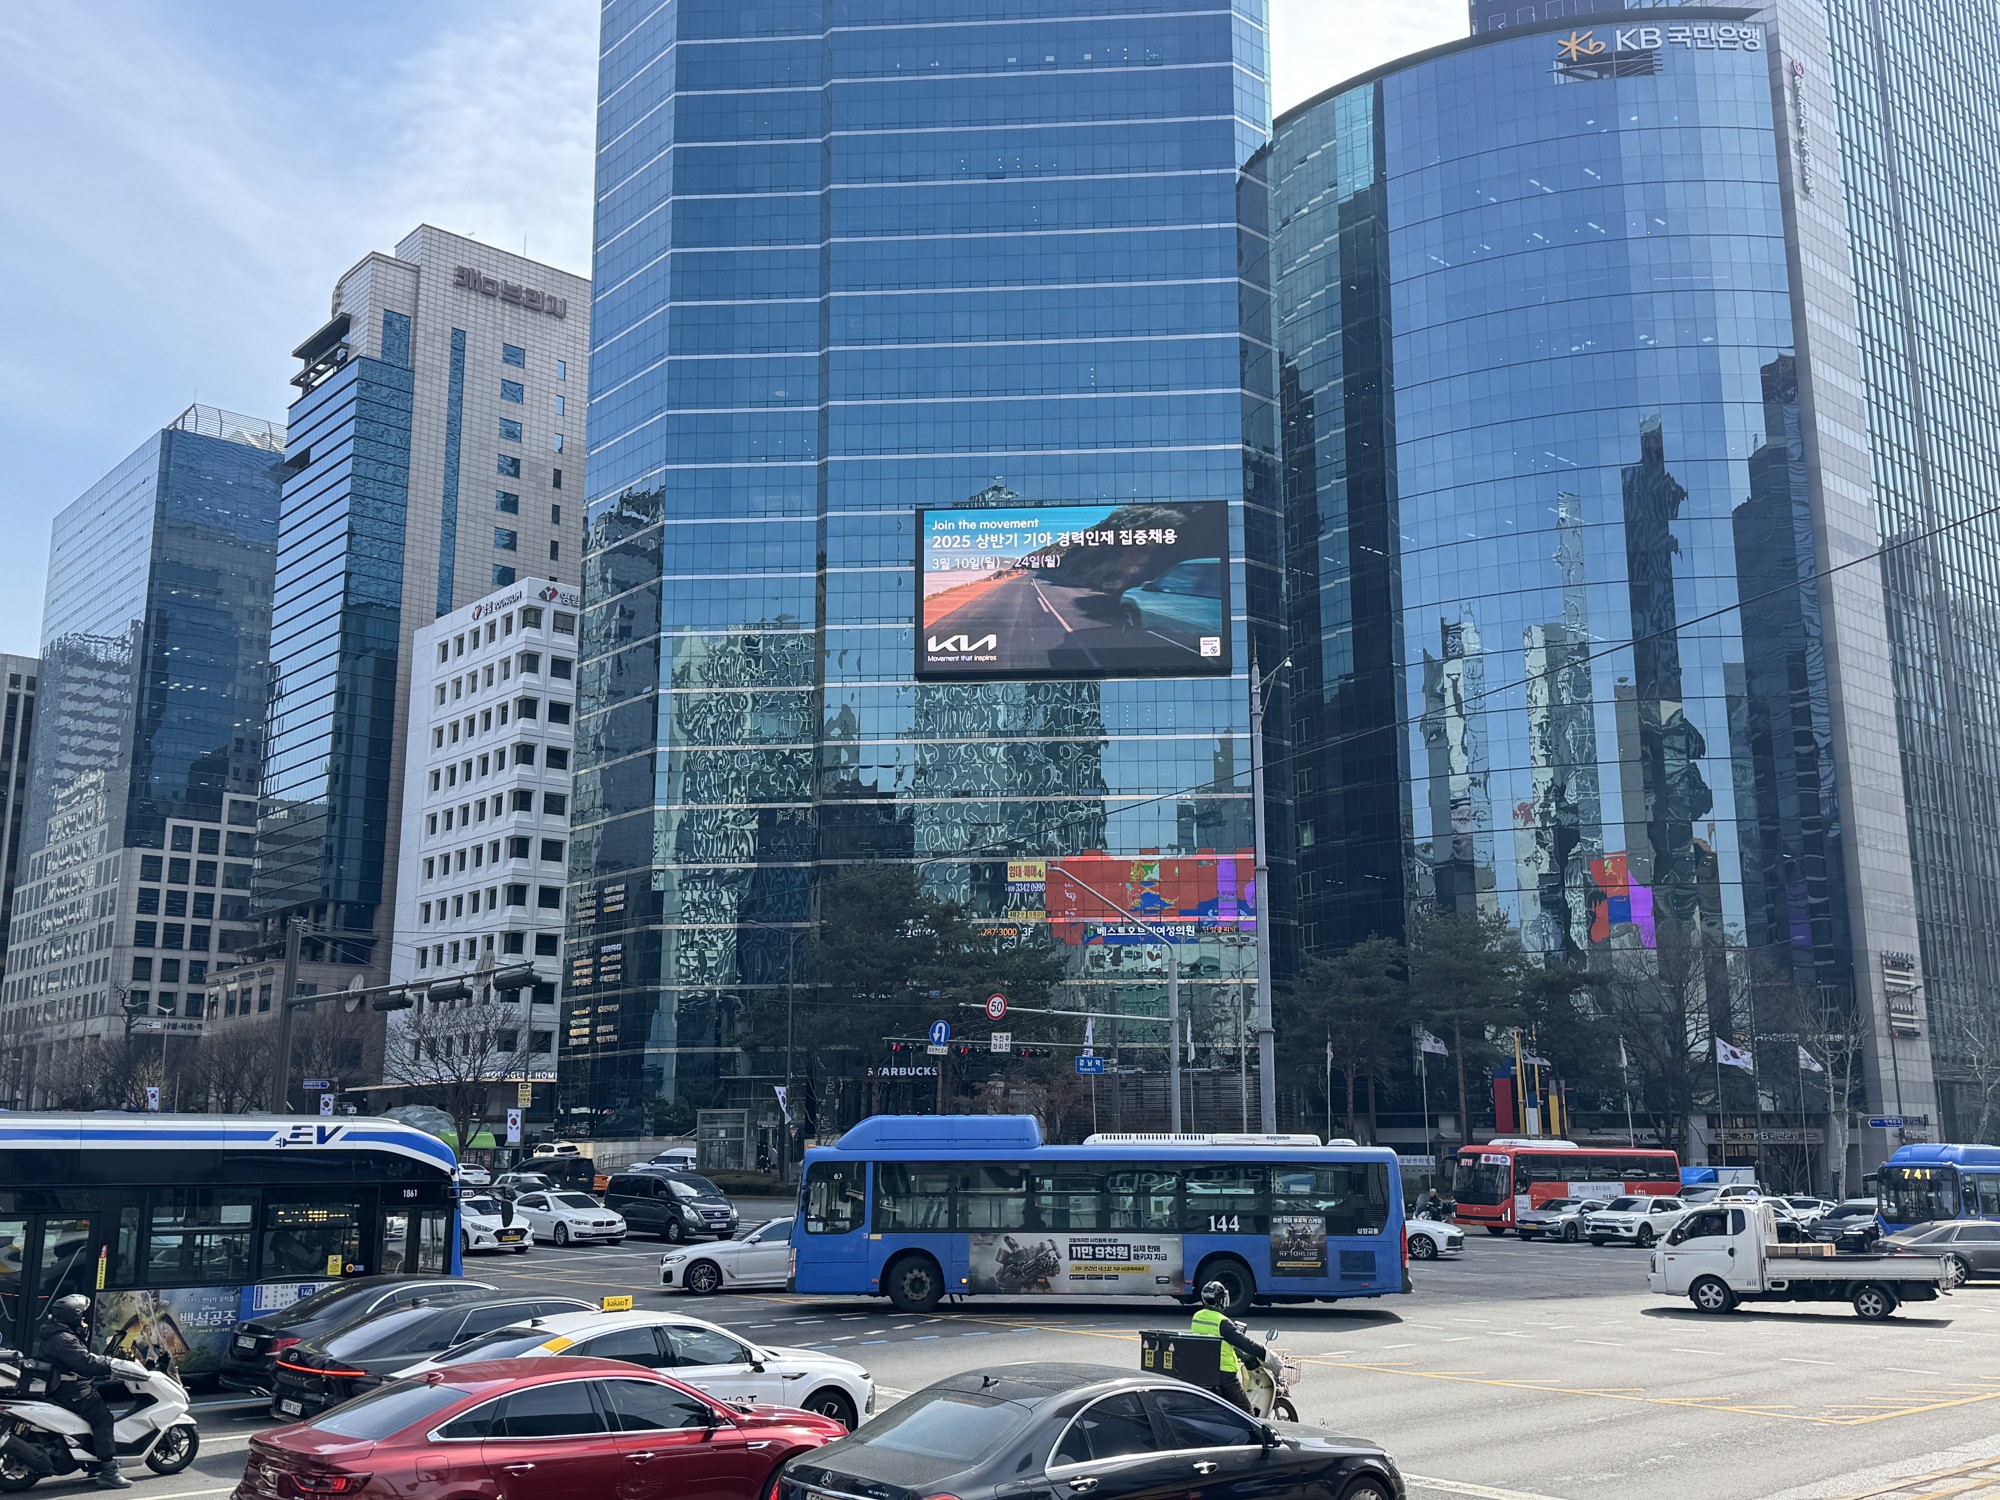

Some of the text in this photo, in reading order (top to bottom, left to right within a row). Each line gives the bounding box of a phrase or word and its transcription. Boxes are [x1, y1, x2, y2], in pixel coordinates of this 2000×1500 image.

[1615, 25, 1761, 51] KB 국민은행
[454, 265, 567, 319] 캠브리지
[932, 517, 1039, 531] Join the movement
[932, 528, 1178, 549] 2025 상반기 기아 경력인재 집중채용
[932, 557, 951, 570] 3월
[954, 555, 1000, 570] 10일(월)
[1014, 554, 1061, 569] 24일(월)
[927, 634, 997, 652] KIA
[1021, 927, 1034, 937] 3F
[990, 1001, 1003, 1013] 50
[1079, 1059, 1101, 1067] 강남역
[535, 1070, 557, 1079] HOM
[289, 1125, 344, 1145] EV
[1902, 1168, 1931, 1180] 741
[403, 1189, 418, 1198] 1861
[1208, 1214, 1240, 1232] 144
[1071, 1246, 1129, 1259] 11만 9천원
[1154, 1253, 1168, 1261] 지급
[300, 1288, 313, 1297] 140
[180, 1309, 237, 1327] 백설공주
